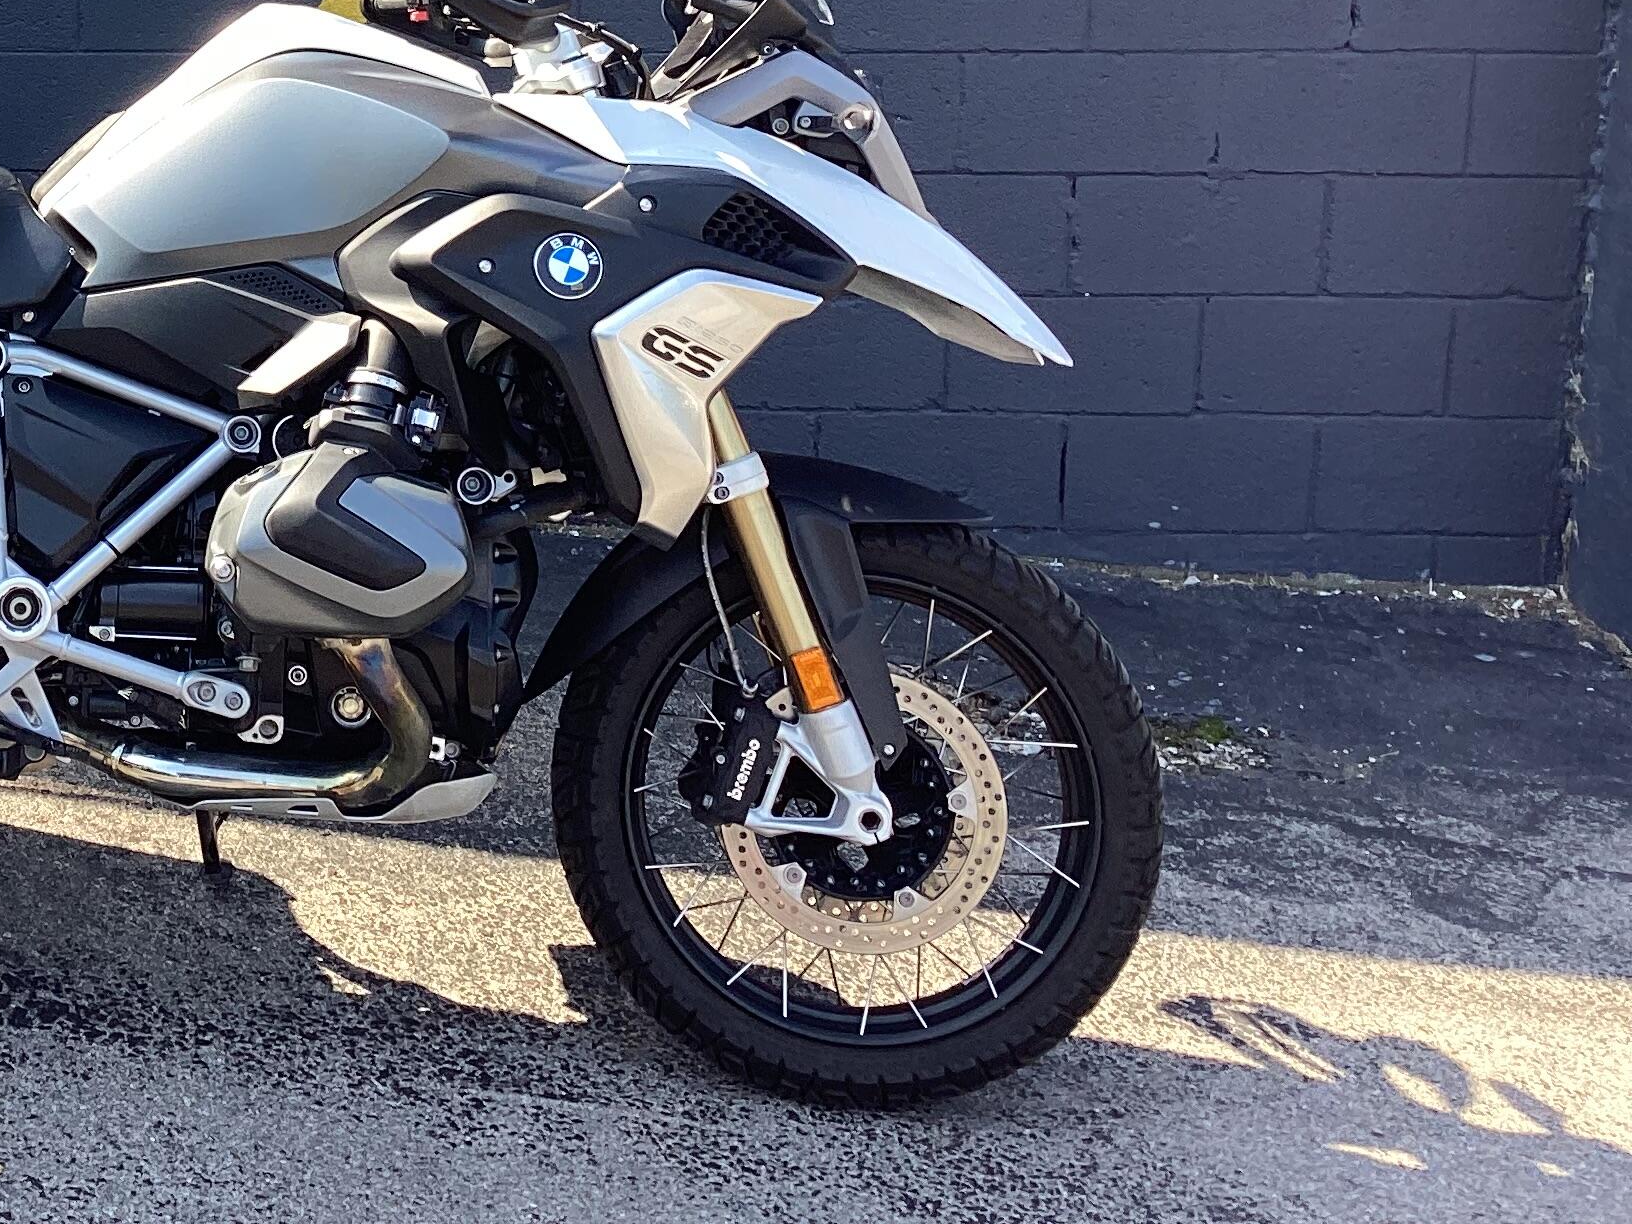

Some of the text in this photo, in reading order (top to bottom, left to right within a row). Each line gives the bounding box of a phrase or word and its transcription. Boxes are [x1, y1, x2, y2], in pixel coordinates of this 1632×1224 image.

[550, 237, 600, 265] BMW
[641, 326, 726, 379] GS
[726, 739, 761, 801] brembo
